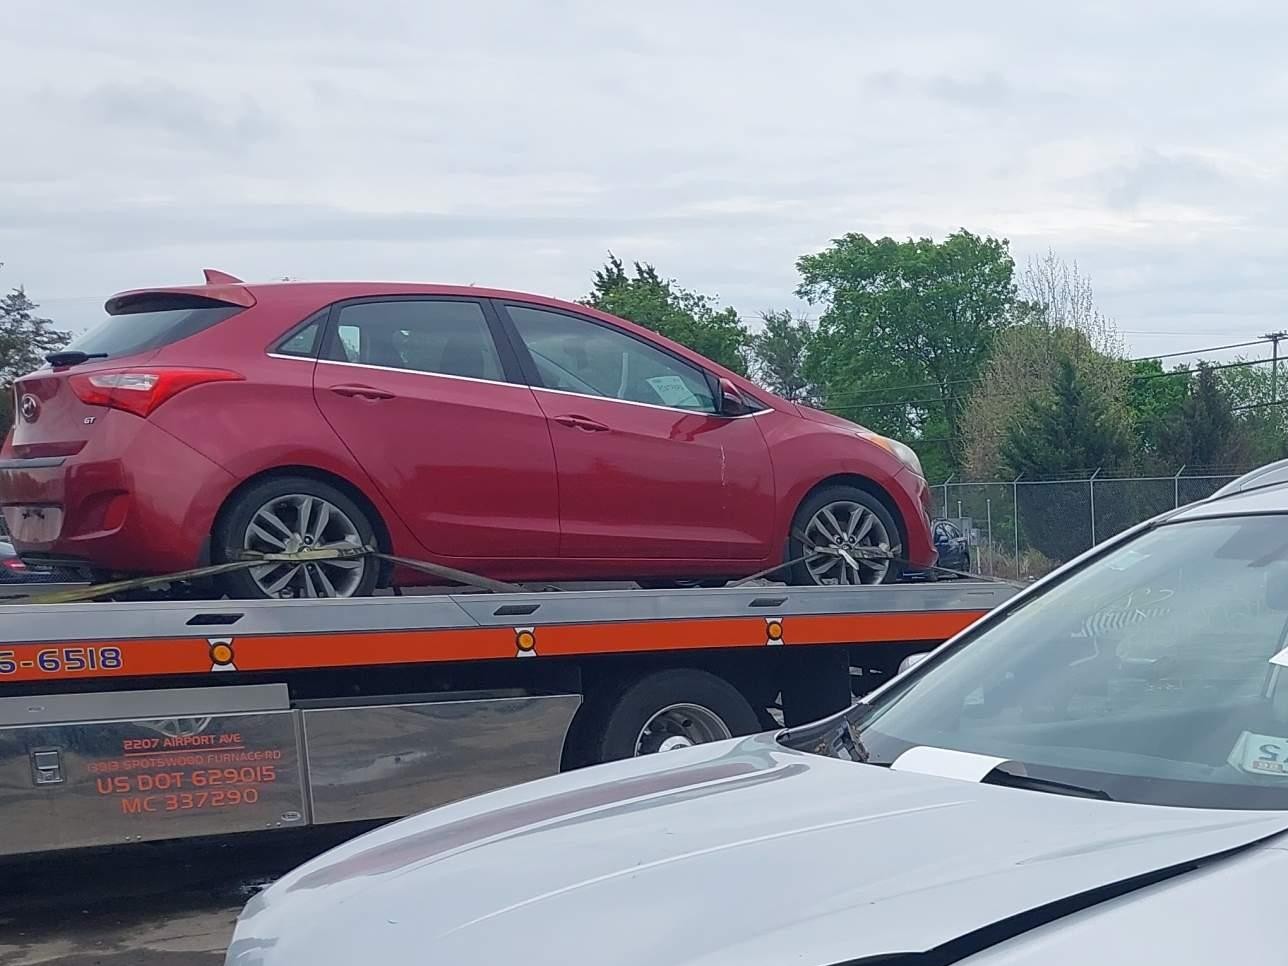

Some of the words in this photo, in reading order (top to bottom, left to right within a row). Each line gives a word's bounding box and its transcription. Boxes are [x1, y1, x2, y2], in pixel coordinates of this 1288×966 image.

[123, 738, 160, 750] 2207
[163, 735, 216, 748] AIRPORT
[219, 733, 242, 744] AVE
[207, 751, 262, 764] FURNACE
[263, 750, 281, 760] RD
[96, 776, 131, 795] US
[137, 772, 185, 791] DOT
[191, 765, 277, 787] 629015
[121, 797, 157, 814] MC
[165, 788, 259, 811] 337290
